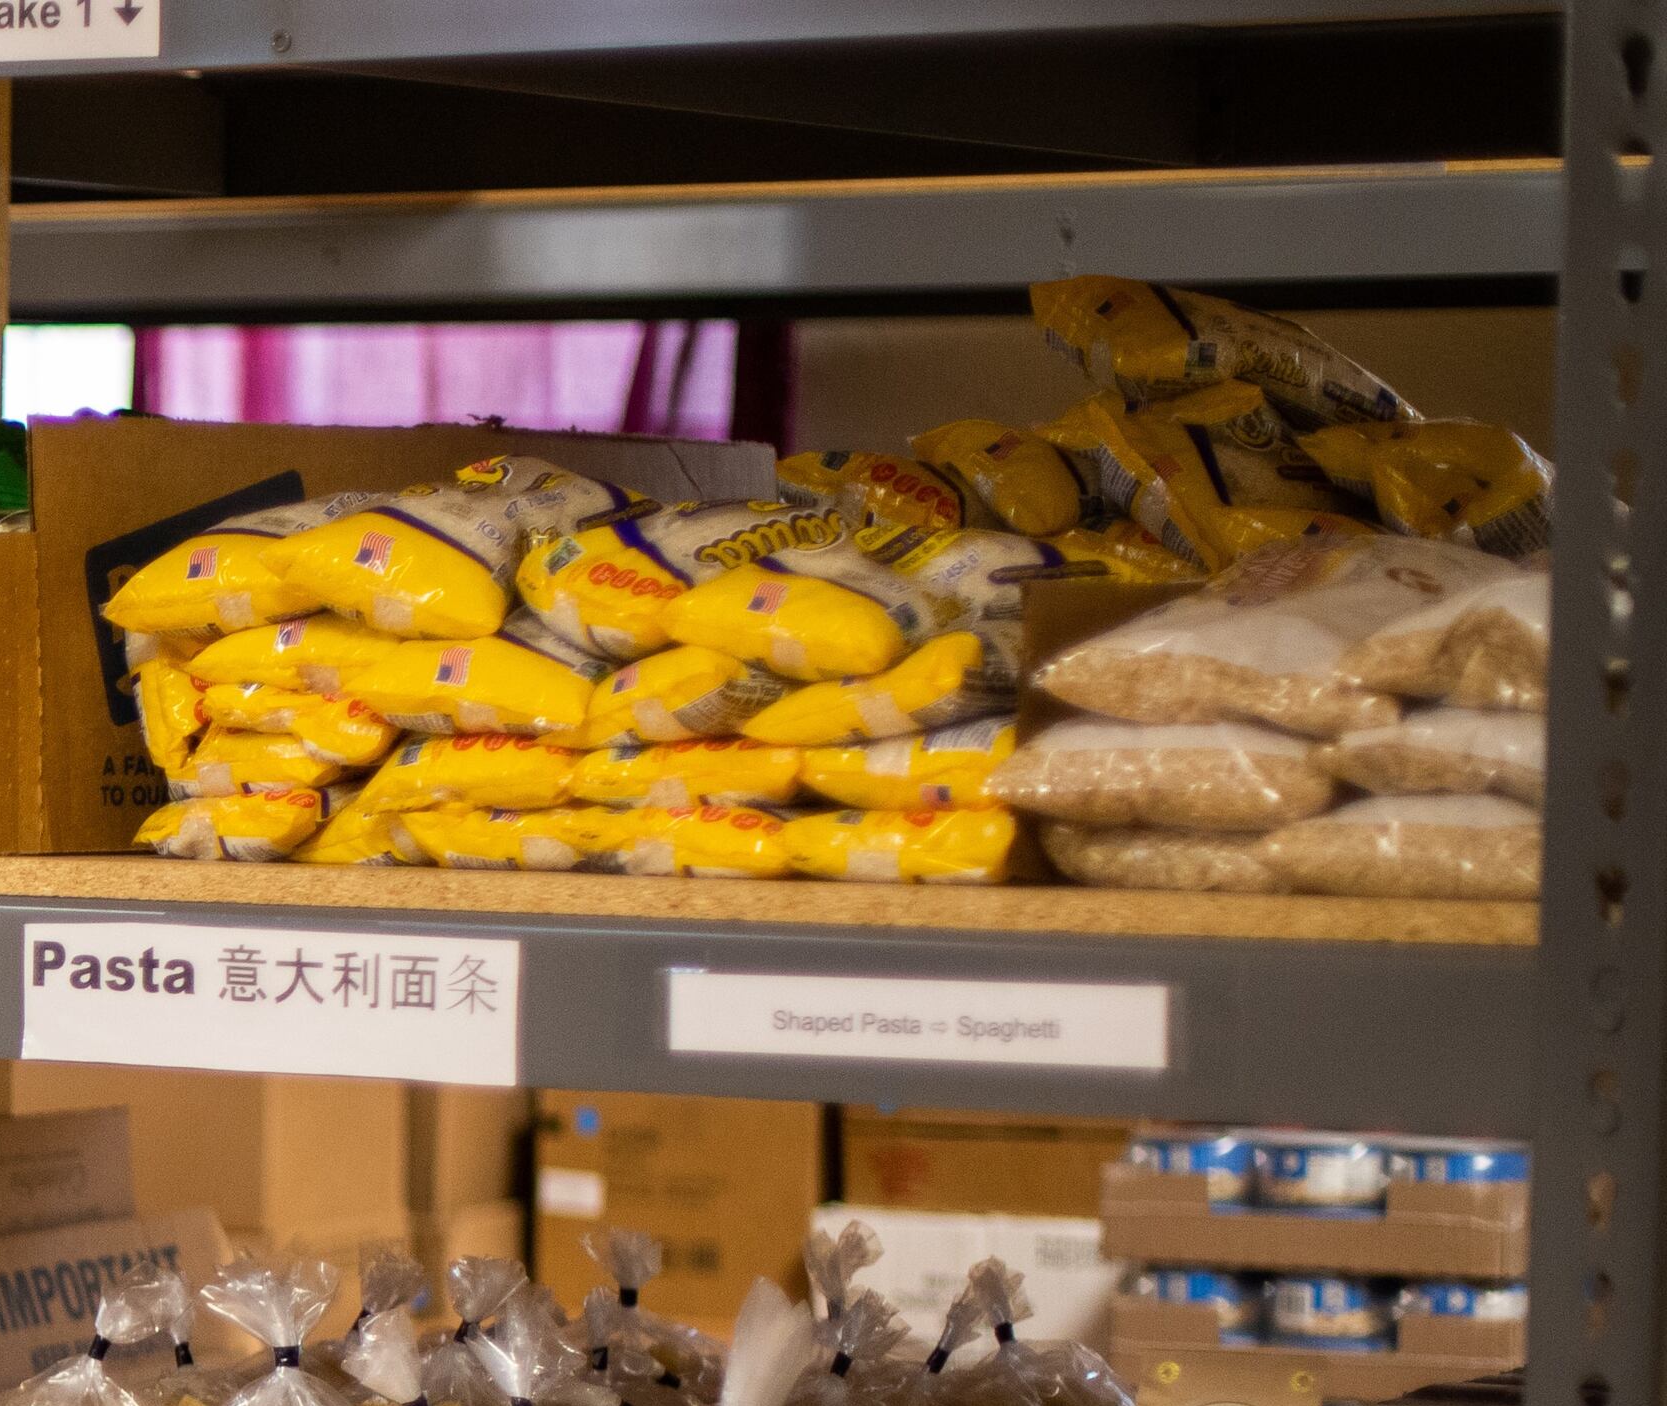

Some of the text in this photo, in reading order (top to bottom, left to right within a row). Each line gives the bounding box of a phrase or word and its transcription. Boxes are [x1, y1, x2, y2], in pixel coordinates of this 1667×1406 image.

[103, 756, 116, 776] A
[101, 785, 126, 807] TO
[31, 940, 499, 1014] Pasta 意大利面条
[773, 1010, 1061, 1042] Shaped Pasta Spaghetti
